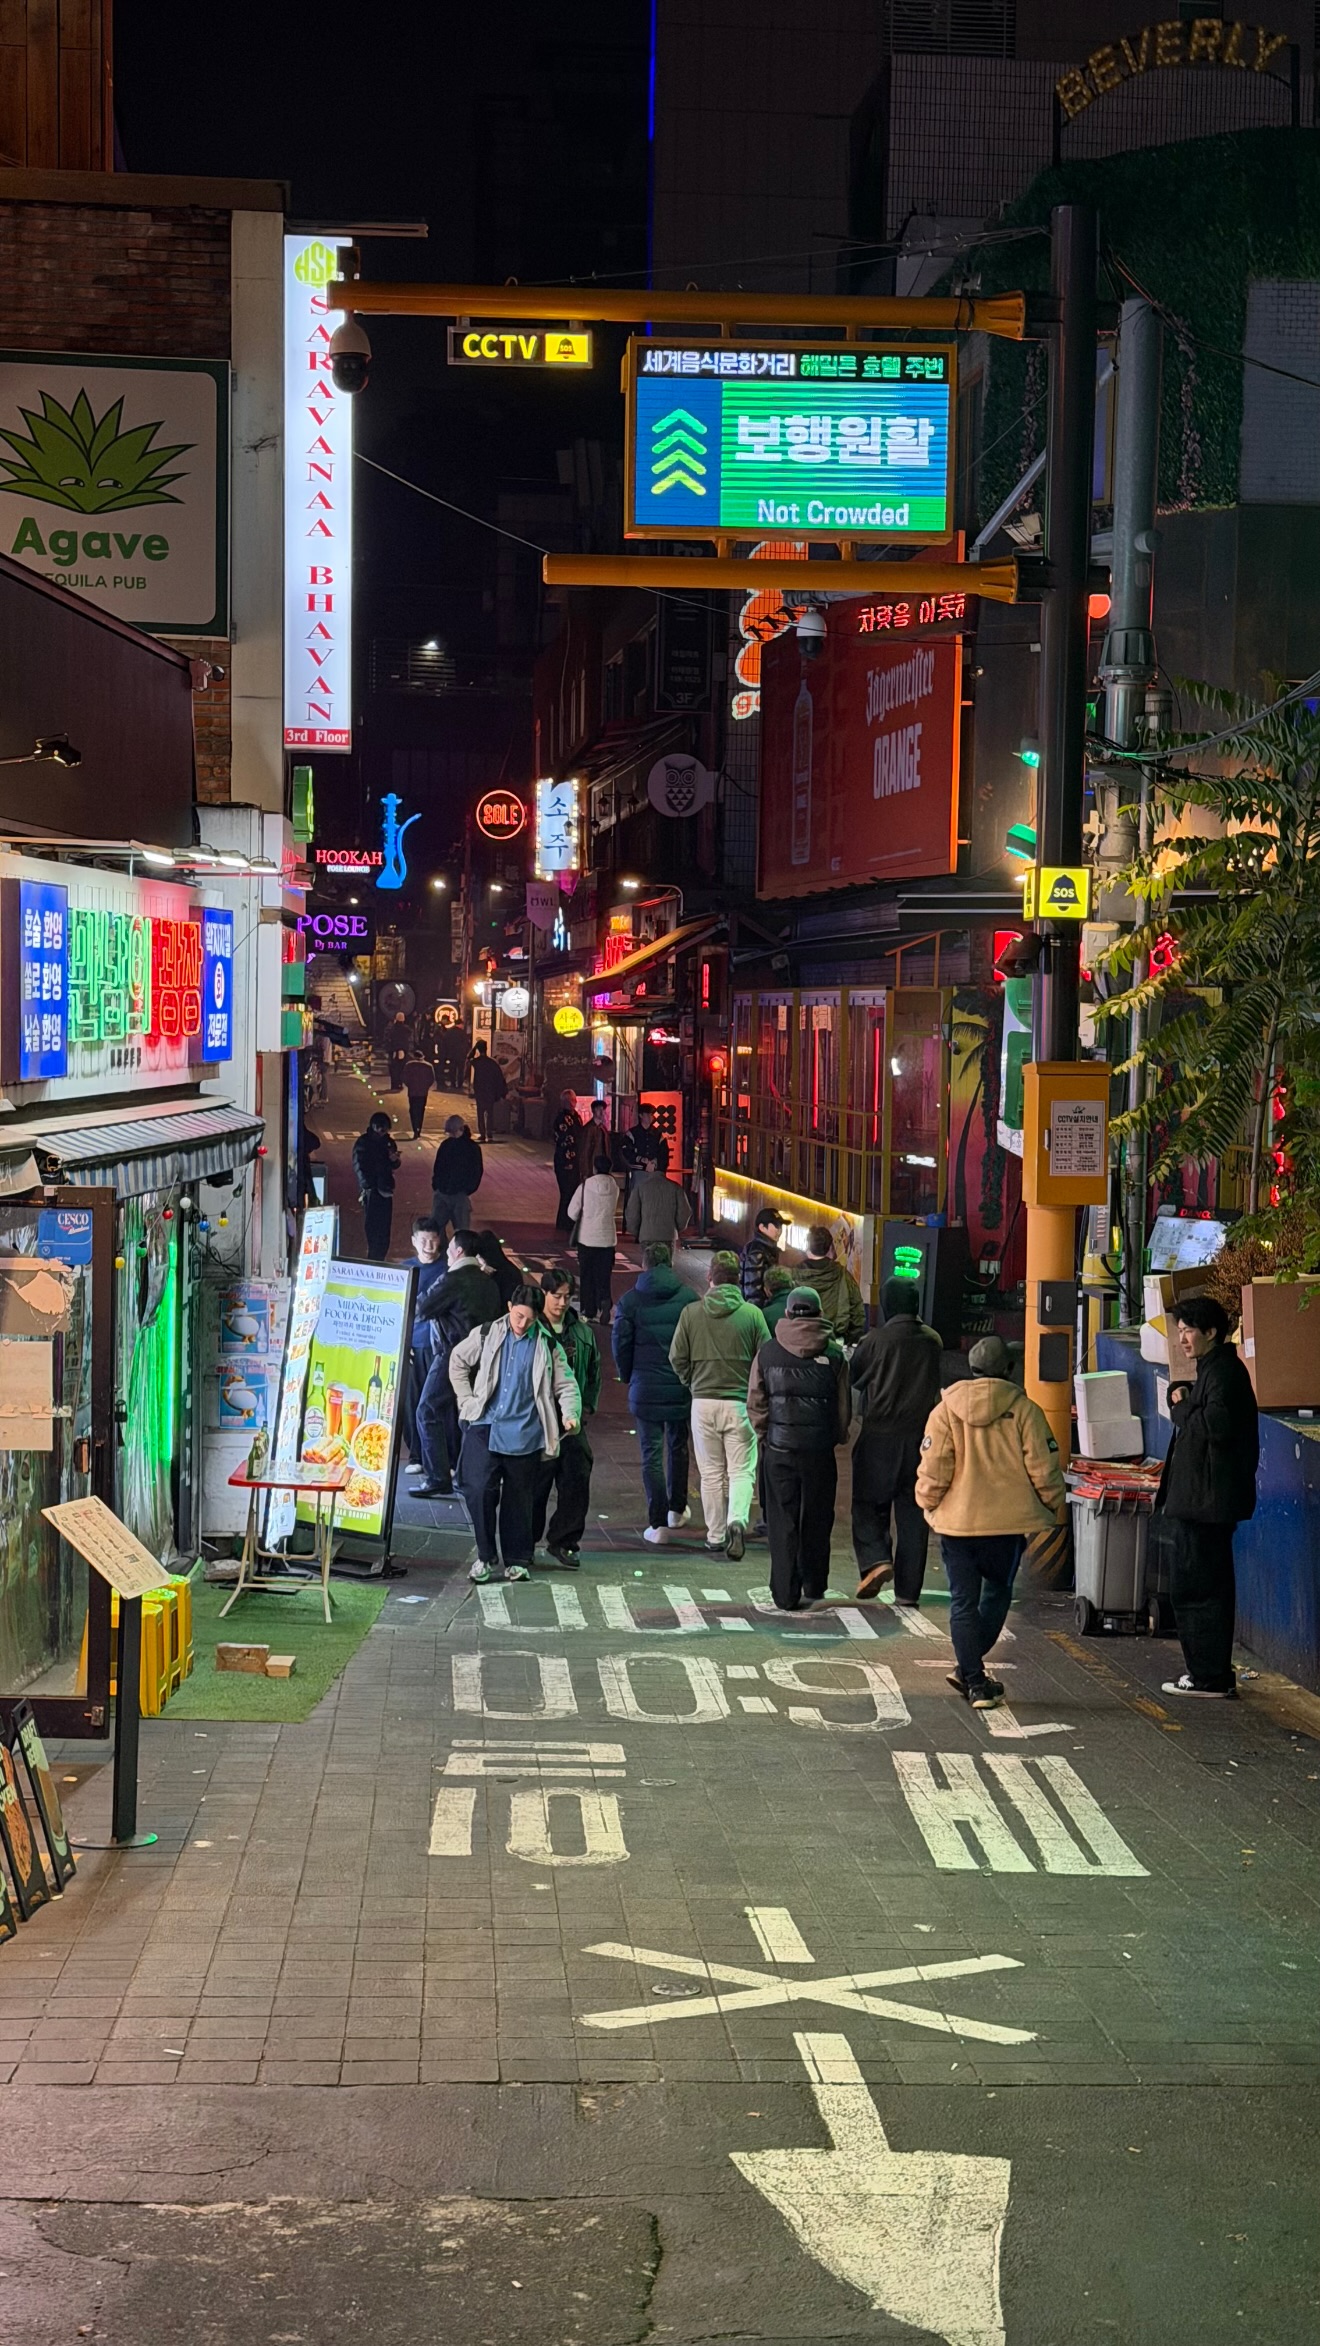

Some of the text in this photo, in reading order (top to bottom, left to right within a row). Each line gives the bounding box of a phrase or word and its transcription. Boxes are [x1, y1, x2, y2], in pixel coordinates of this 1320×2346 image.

[1056, 17, 1288, 118] BEVERLY
[463, 333, 537, 360] CCTV
[643, 350, 796, 376] 세계음식문화거리
[861, 355, 900, 378] 호텔
[905, 356, 943, 379] 주변
[734, 414, 934, 466] 보행원활
[305, 295, 336, 722] SARAVANAA BHAVAN
[757, 501, 909, 526] Not Crowded
[11, 516, 170, 567] Agave
[42, 572, 147, 590] EQUILA PUB
[286, 728, 350, 746] 3rd Floor
[873, 722, 923, 799] ORANGE
[483, 804, 518, 825] SOLE
[545, 796, 570, 859] 소주
[316, 849, 383, 865] HOOKAH
[1053, 887, 1075, 898] SOS
[43, 910, 62, 950] 환영
[296, 915, 368, 936] POSE
[328, 941, 347, 949] BAR
[42, 962, 62, 1000] 환영
[42, 1013, 62, 1052] 환영
[207, 1013, 228, 1048] 전문점
[57, 1212, 89, 1225] CESCO
[324, 1307, 396, 1327] FOOD & DRINKS
[337, 1299, 382, 1315] MIDNIGHT
